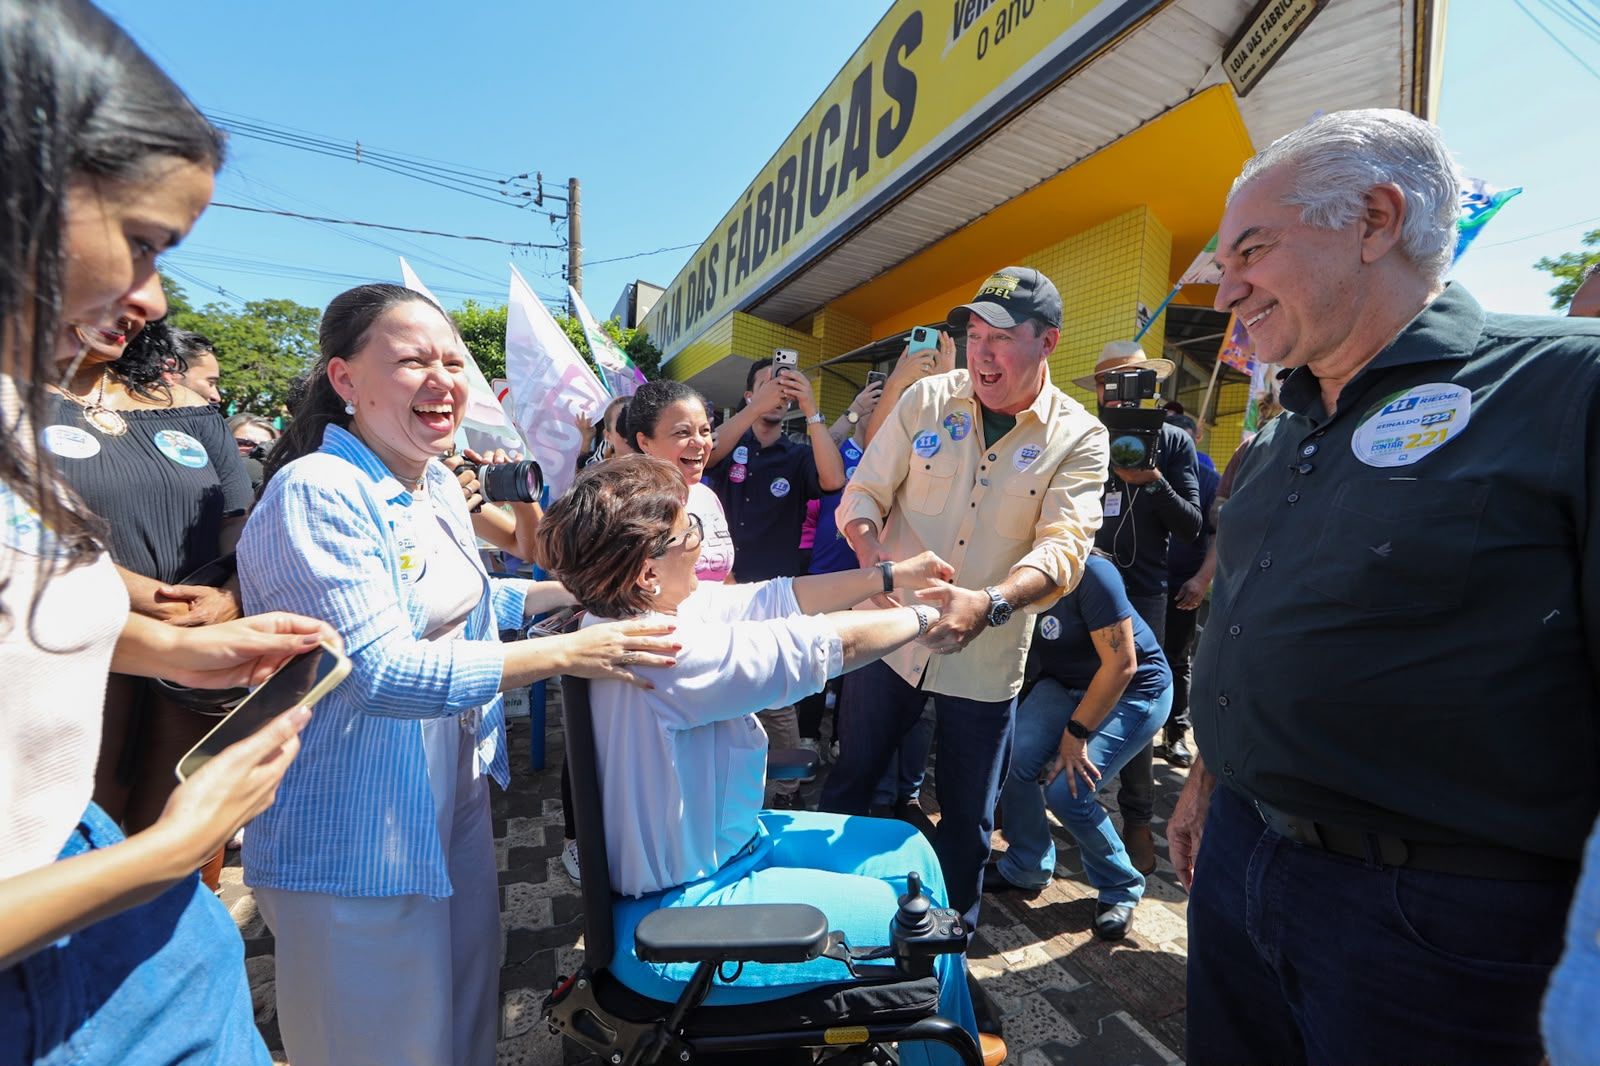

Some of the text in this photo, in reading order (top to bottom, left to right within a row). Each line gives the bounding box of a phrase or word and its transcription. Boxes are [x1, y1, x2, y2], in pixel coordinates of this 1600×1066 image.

[977, 26, 989, 60] o
[1230, 0, 1294, 73] LOJA DAS FÁBRIC
[1259, 37, 1278, 59] Mesa
[1281, 3, 1307, 32] Banho
[656, 10, 923, 348] LOJA DAS FÁBRICAS
[1404, 427, 1449, 449] 221
